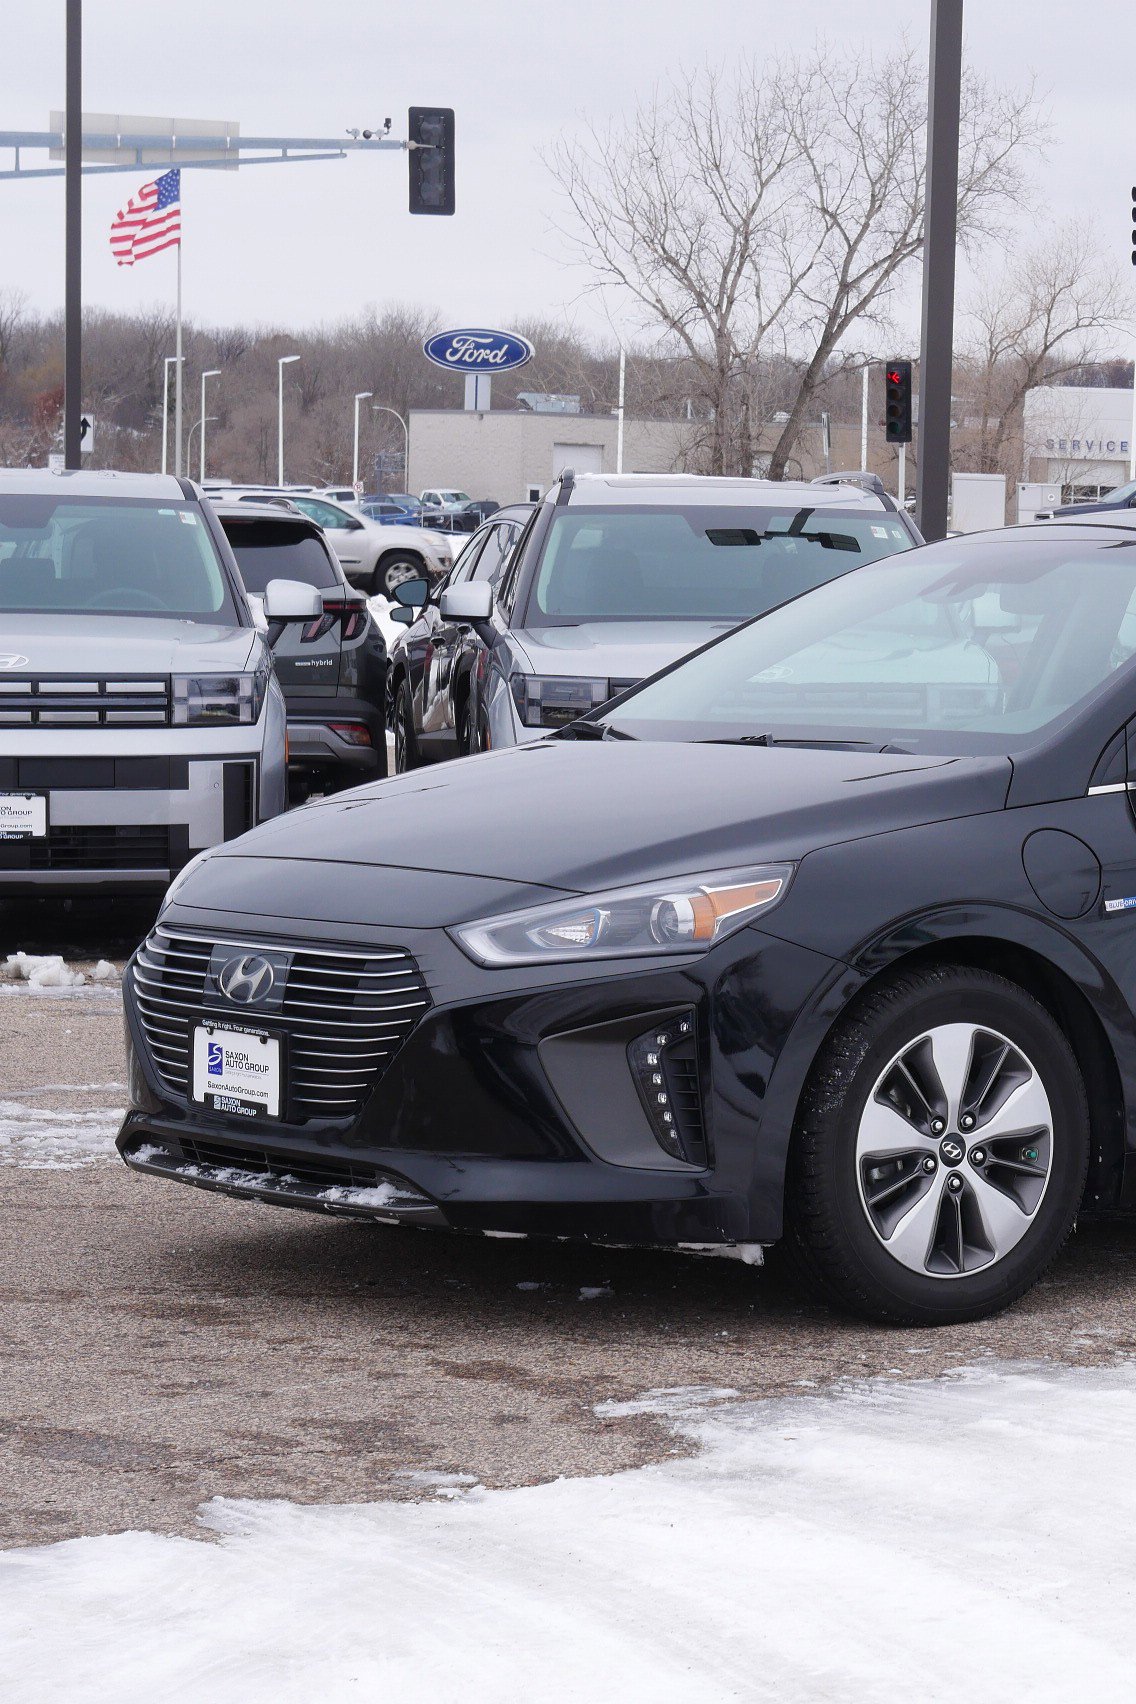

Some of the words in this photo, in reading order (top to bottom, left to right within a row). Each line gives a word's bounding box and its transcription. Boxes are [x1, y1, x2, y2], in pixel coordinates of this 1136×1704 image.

[445, 335, 509, 364] Ford
[1046, 438, 1129, 452] SERVICE
[311, 659, 333, 667] hybrid
[225, 1050, 249, 1062] SAXON
[225, 1059, 244, 1070] AUTO
[244, 1062, 270, 1074] GROUP
[207, 1080, 269, 1099] SaxonAutoGroup.com
[221, 1096, 241, 1107] SAXON
[220, 1104, 236, 1114] AUTO
[236, 1106, 257, 1117] GROUP
